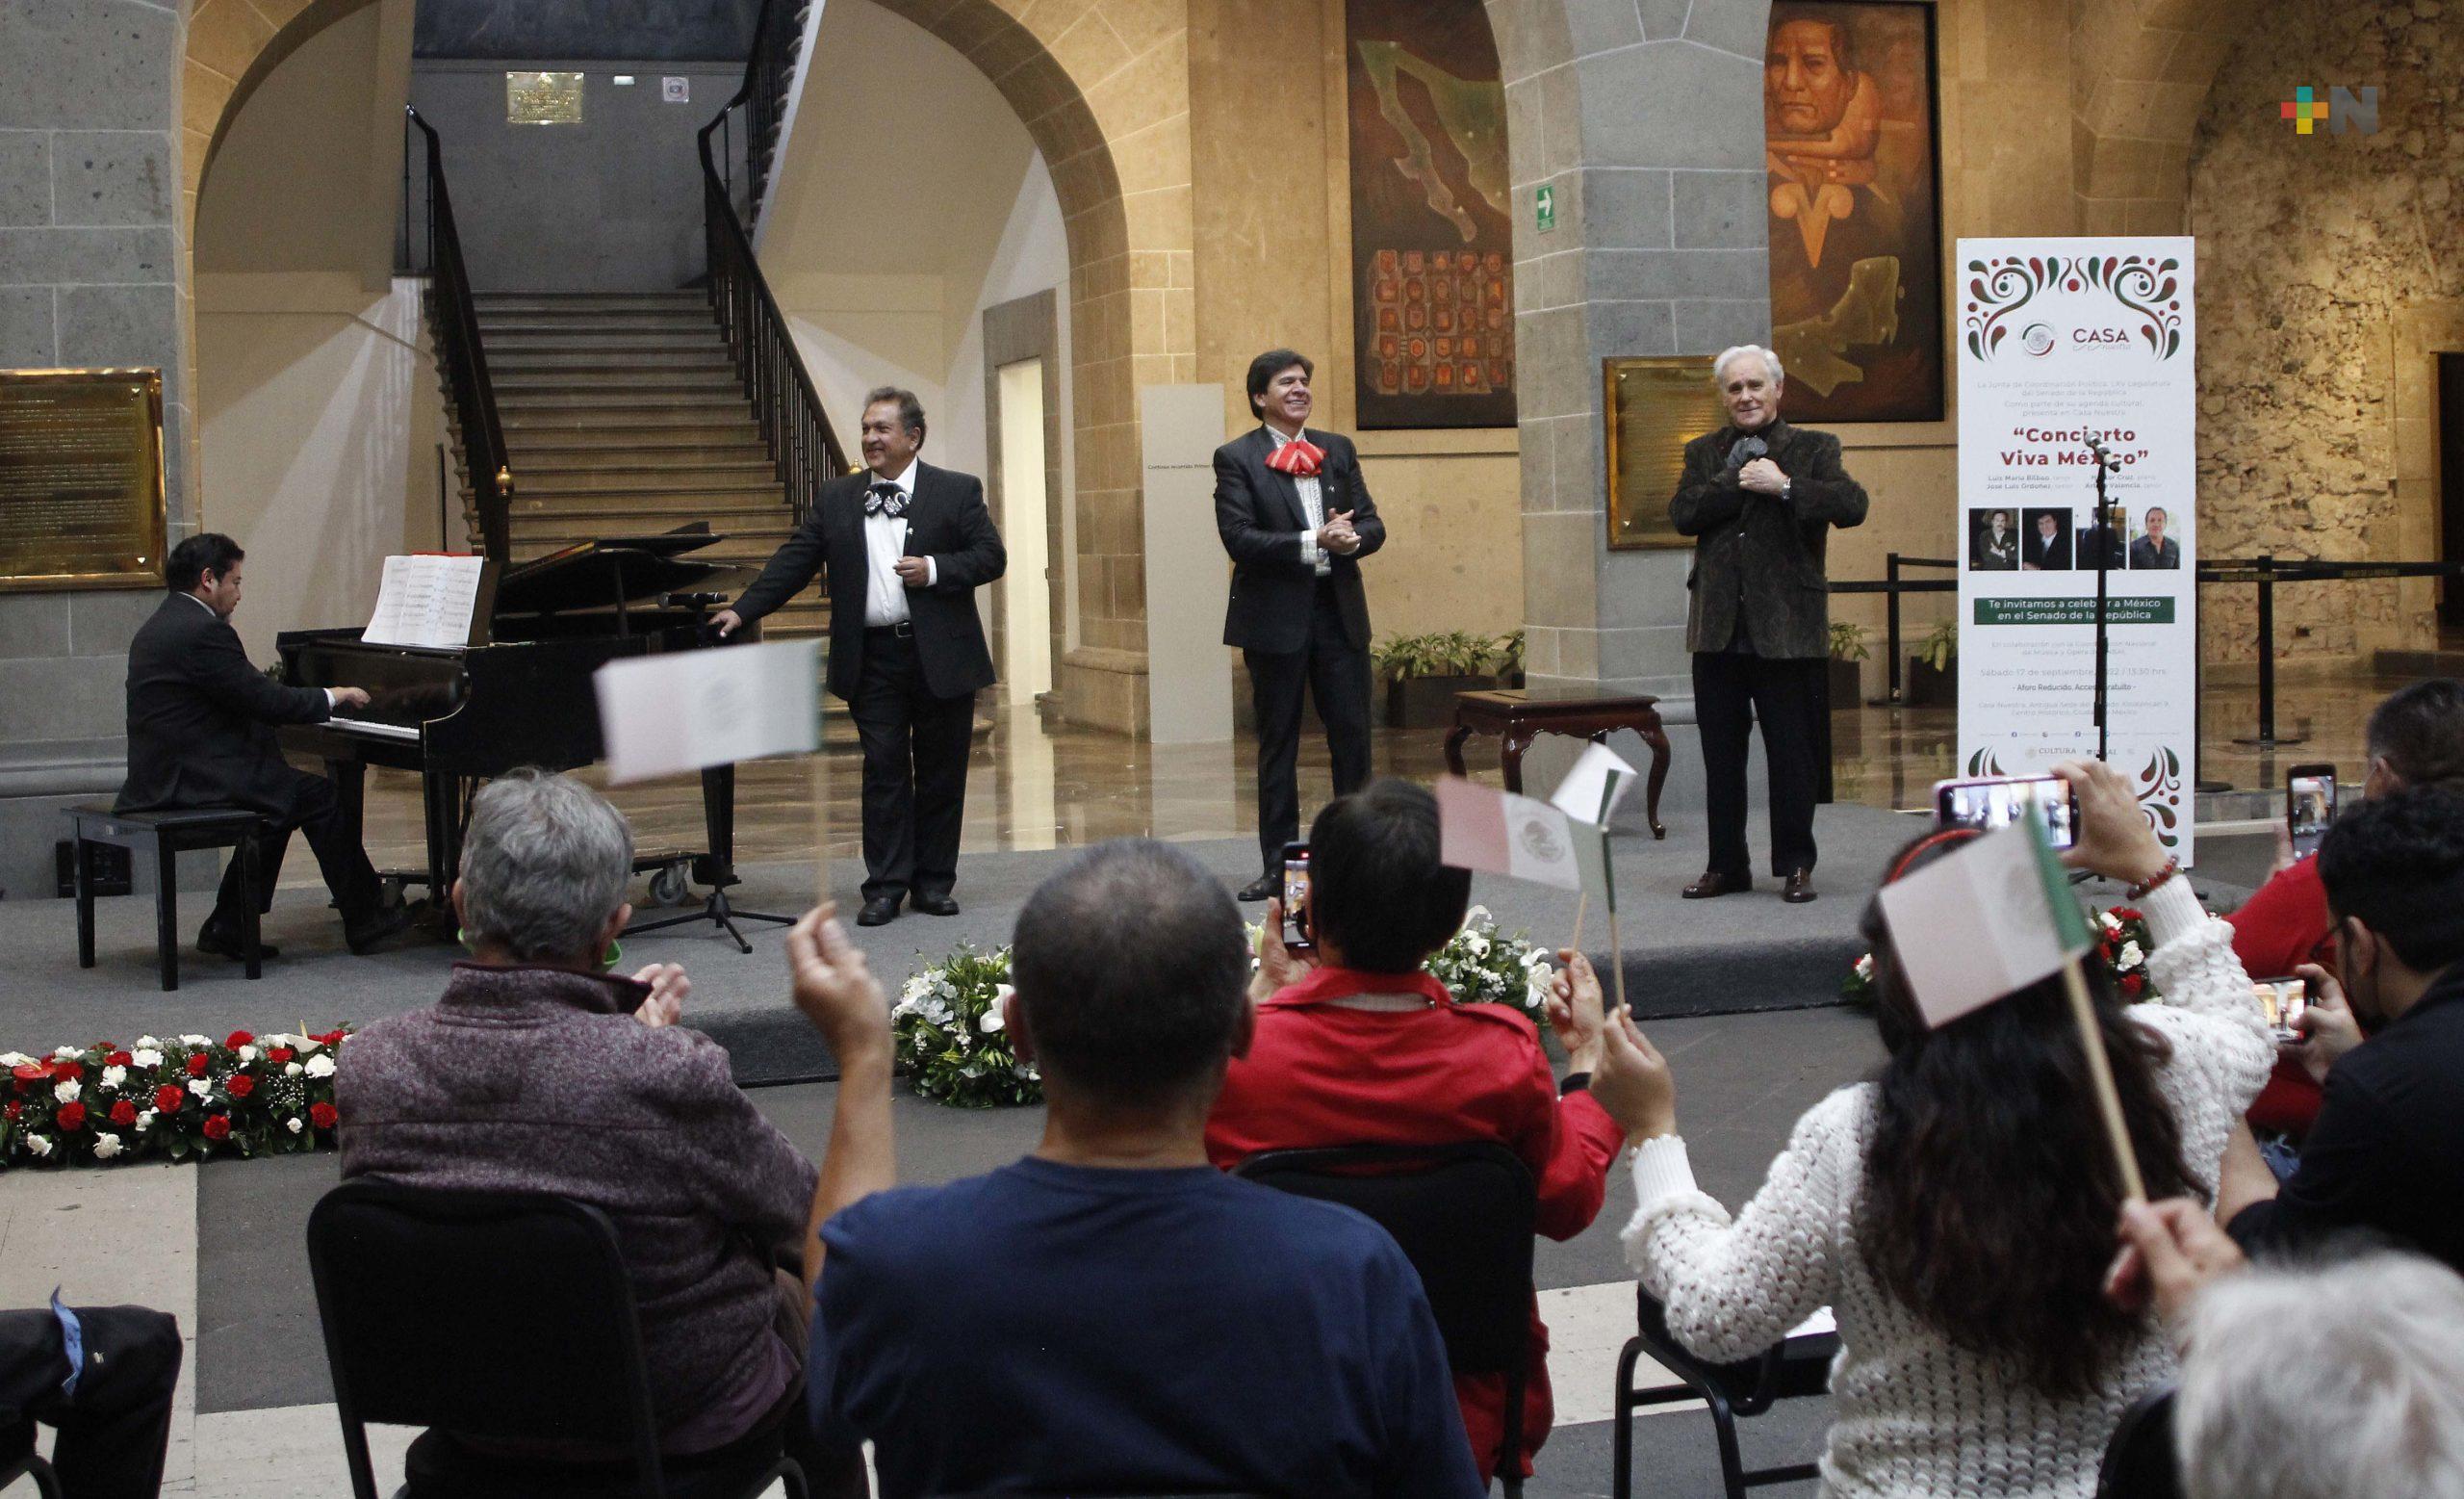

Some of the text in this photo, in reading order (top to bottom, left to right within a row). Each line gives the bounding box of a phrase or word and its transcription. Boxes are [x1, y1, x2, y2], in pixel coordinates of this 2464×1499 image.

[2073, 328, 2130, 343] CASA
[2001, 449, 2049, 466] Viva
[1989, 600, 2000, 608] Te
[2004, 599, 2056, 608] invitamos
[2067, 599, 2111, 608] celebr
[2123, 598, 2161, 607] México
[2015, 611, 2024, 620] el
[2027, 610, 2066, 620] Senado
[2069, 610, 2084, 619] de
[2086, 610, 2095, 619] la
[2101, 609, 2151, 621] epública
